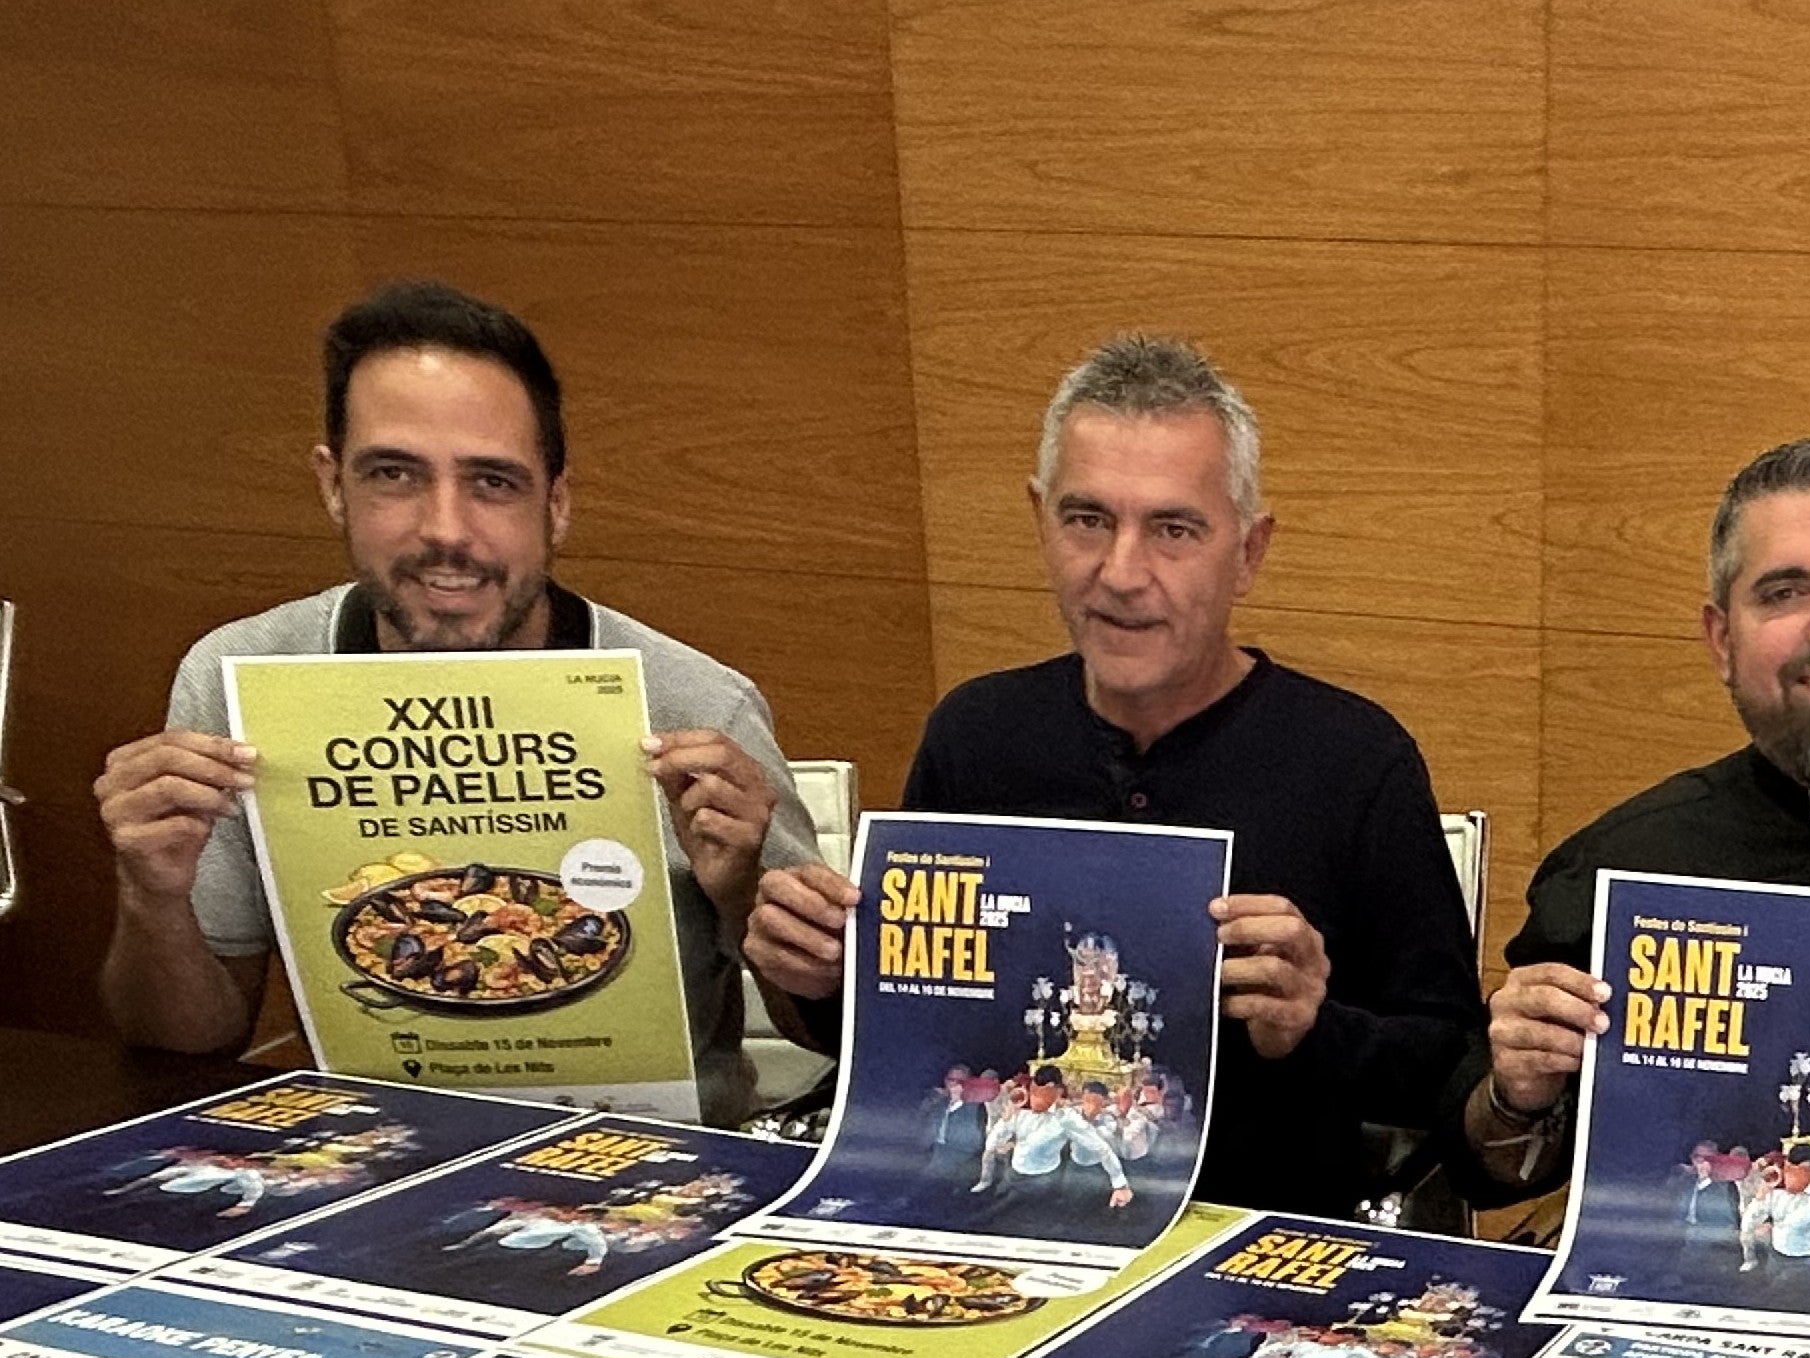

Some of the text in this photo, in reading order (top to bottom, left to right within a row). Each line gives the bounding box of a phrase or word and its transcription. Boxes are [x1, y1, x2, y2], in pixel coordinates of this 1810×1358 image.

[384, 696, 494, 731] XXIII
[326, 733, 577, 771] CONCURS
[308, 768, 605, 808] DE PAELLES
[359, 809, 567, 838] DE SANTÍSSIM
[881, 868, 983, 925] SANT
[879, 923, 995, 983] RAFEL
[1628, 934, 1741, 996] SANT
[1623, 992, 1749, 1056] RAFEL
[1245, 1232, 1366, 1266] SANT
[1214, 1252, 1349, 1288] RAFEL
